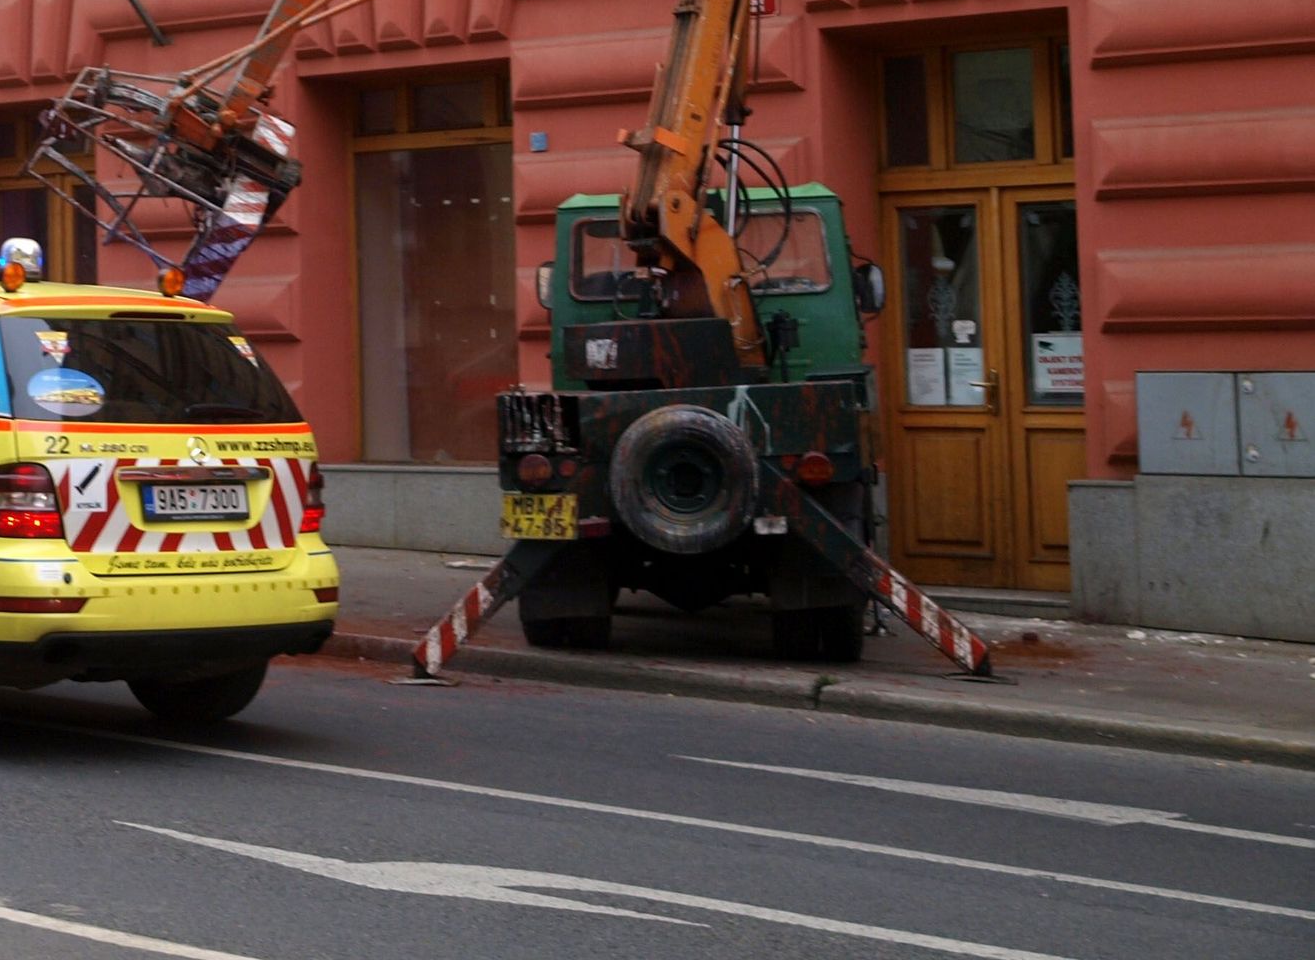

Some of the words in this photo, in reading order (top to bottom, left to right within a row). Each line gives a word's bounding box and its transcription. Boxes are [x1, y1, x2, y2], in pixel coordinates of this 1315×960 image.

[45, 436, 70, 454] 22
[157, 489, 188, 511] 9A5
[199, 488, 241, 511] 7300
